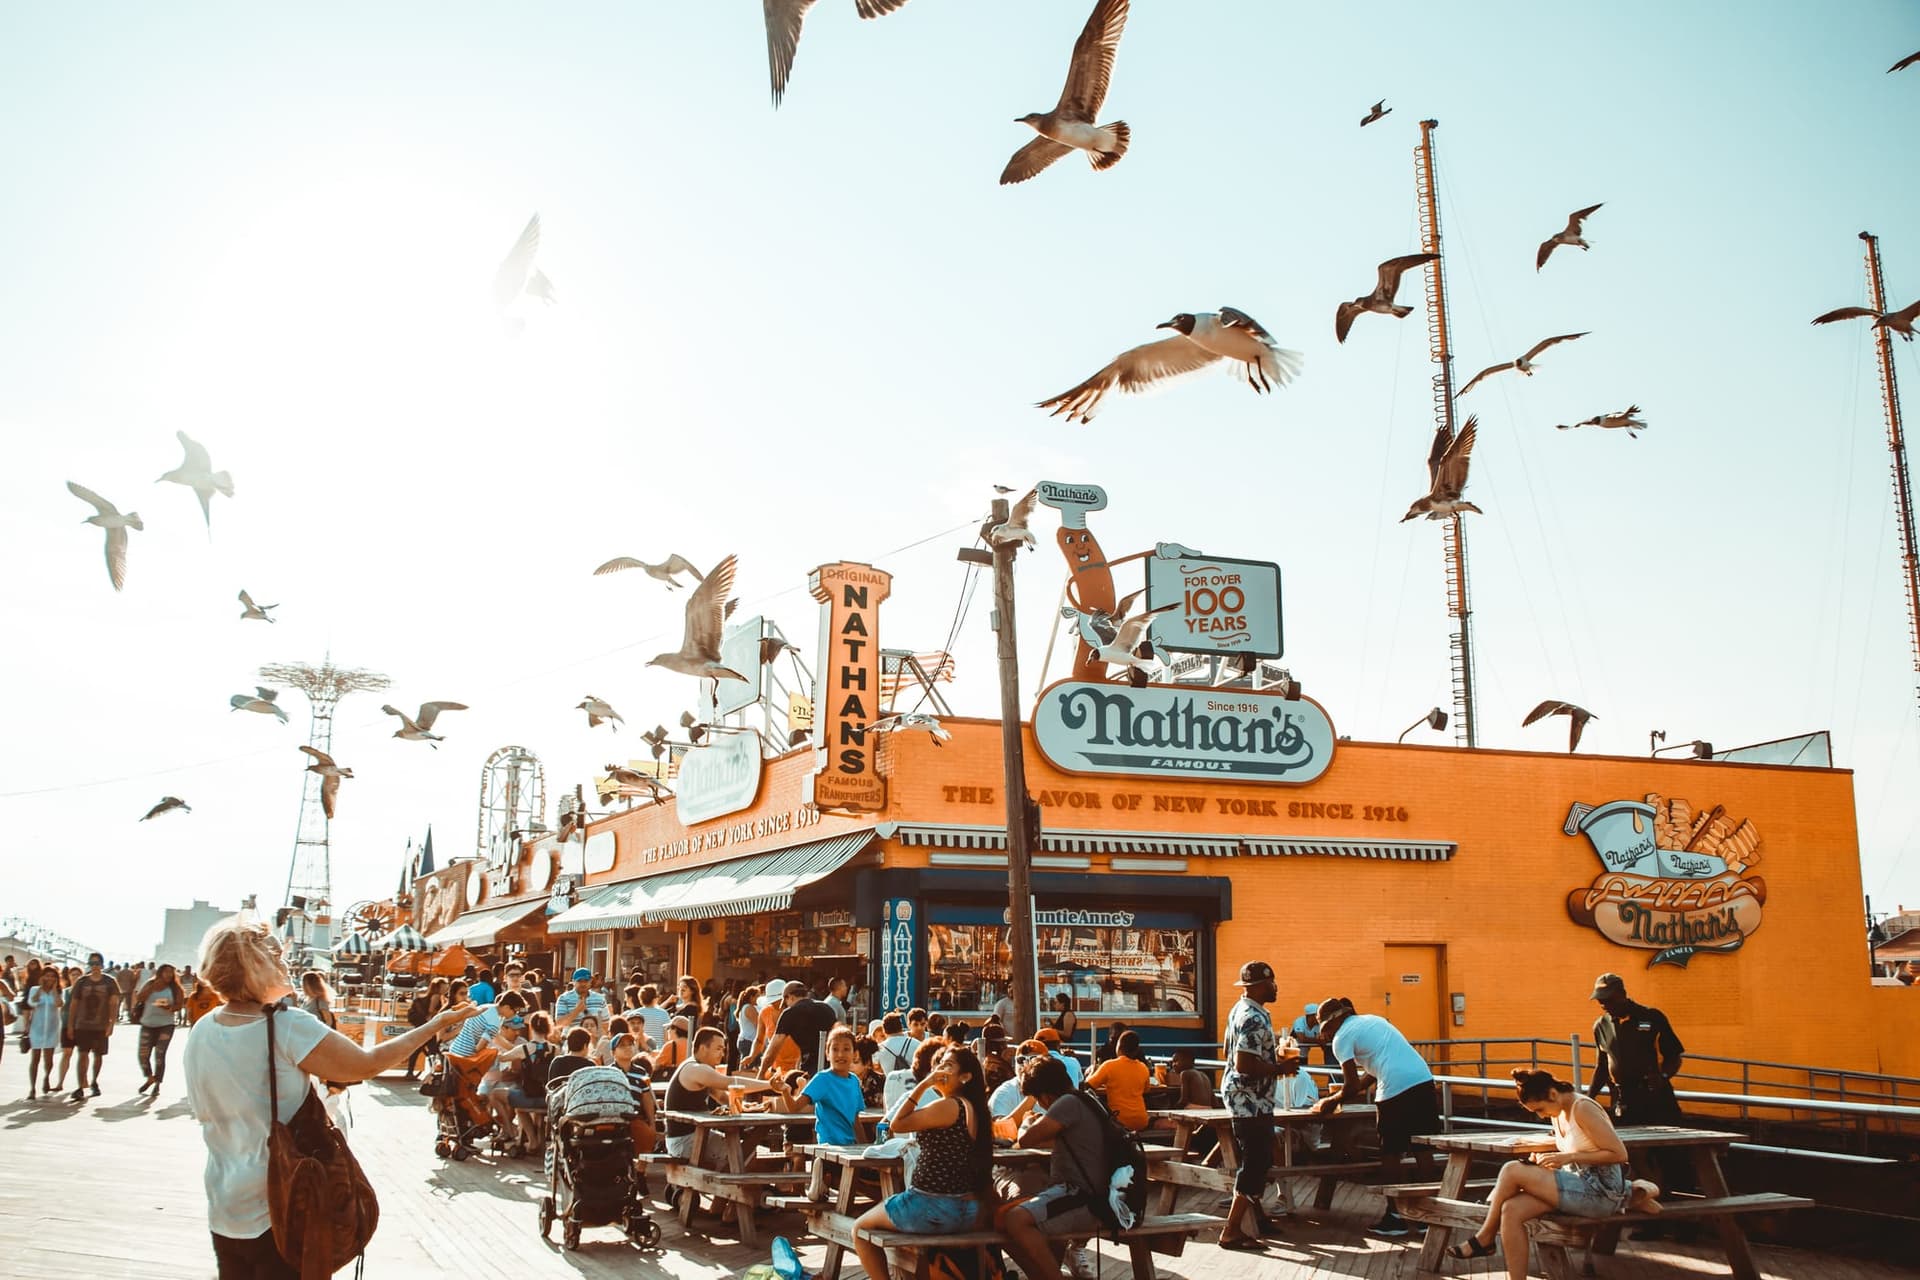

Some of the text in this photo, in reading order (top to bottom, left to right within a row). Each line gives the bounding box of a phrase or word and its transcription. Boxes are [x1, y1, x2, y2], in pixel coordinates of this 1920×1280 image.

[1042, 484, 1098, 501] Nathan's
[827, 569, 885, 585] ORIGINAL
[1184, 574, 1242, 587] FOR OVER
[1184, 586, 1245, 616] 100
[1184, 615, 1247, 633] YEARS
[839, 584, 868, 775] NATHANS
[1207, 700, 1259, 714] Since 1916
[1058, 687, 1313, 756] Nathan's
[1150, 758, 1232, 770] FAMOUS
[828, 776, 874, 787] FAMOUS
[942, 786, 1409, 822] THE AVOR OF NEW YORK SINCE 1916
[642, 808, 821, 864] THE FLAVOR OF NEW YORK SINCE 1916
[1605, 838, 1655, 866] Nathan's
[1670, 854, 1712, 870] Nathan's
[1035, 909, 1133, 927] untie Anne's
[1618, 901, 1740, 944] Nathan's
[893, 922, 912, 1010] Auntie
